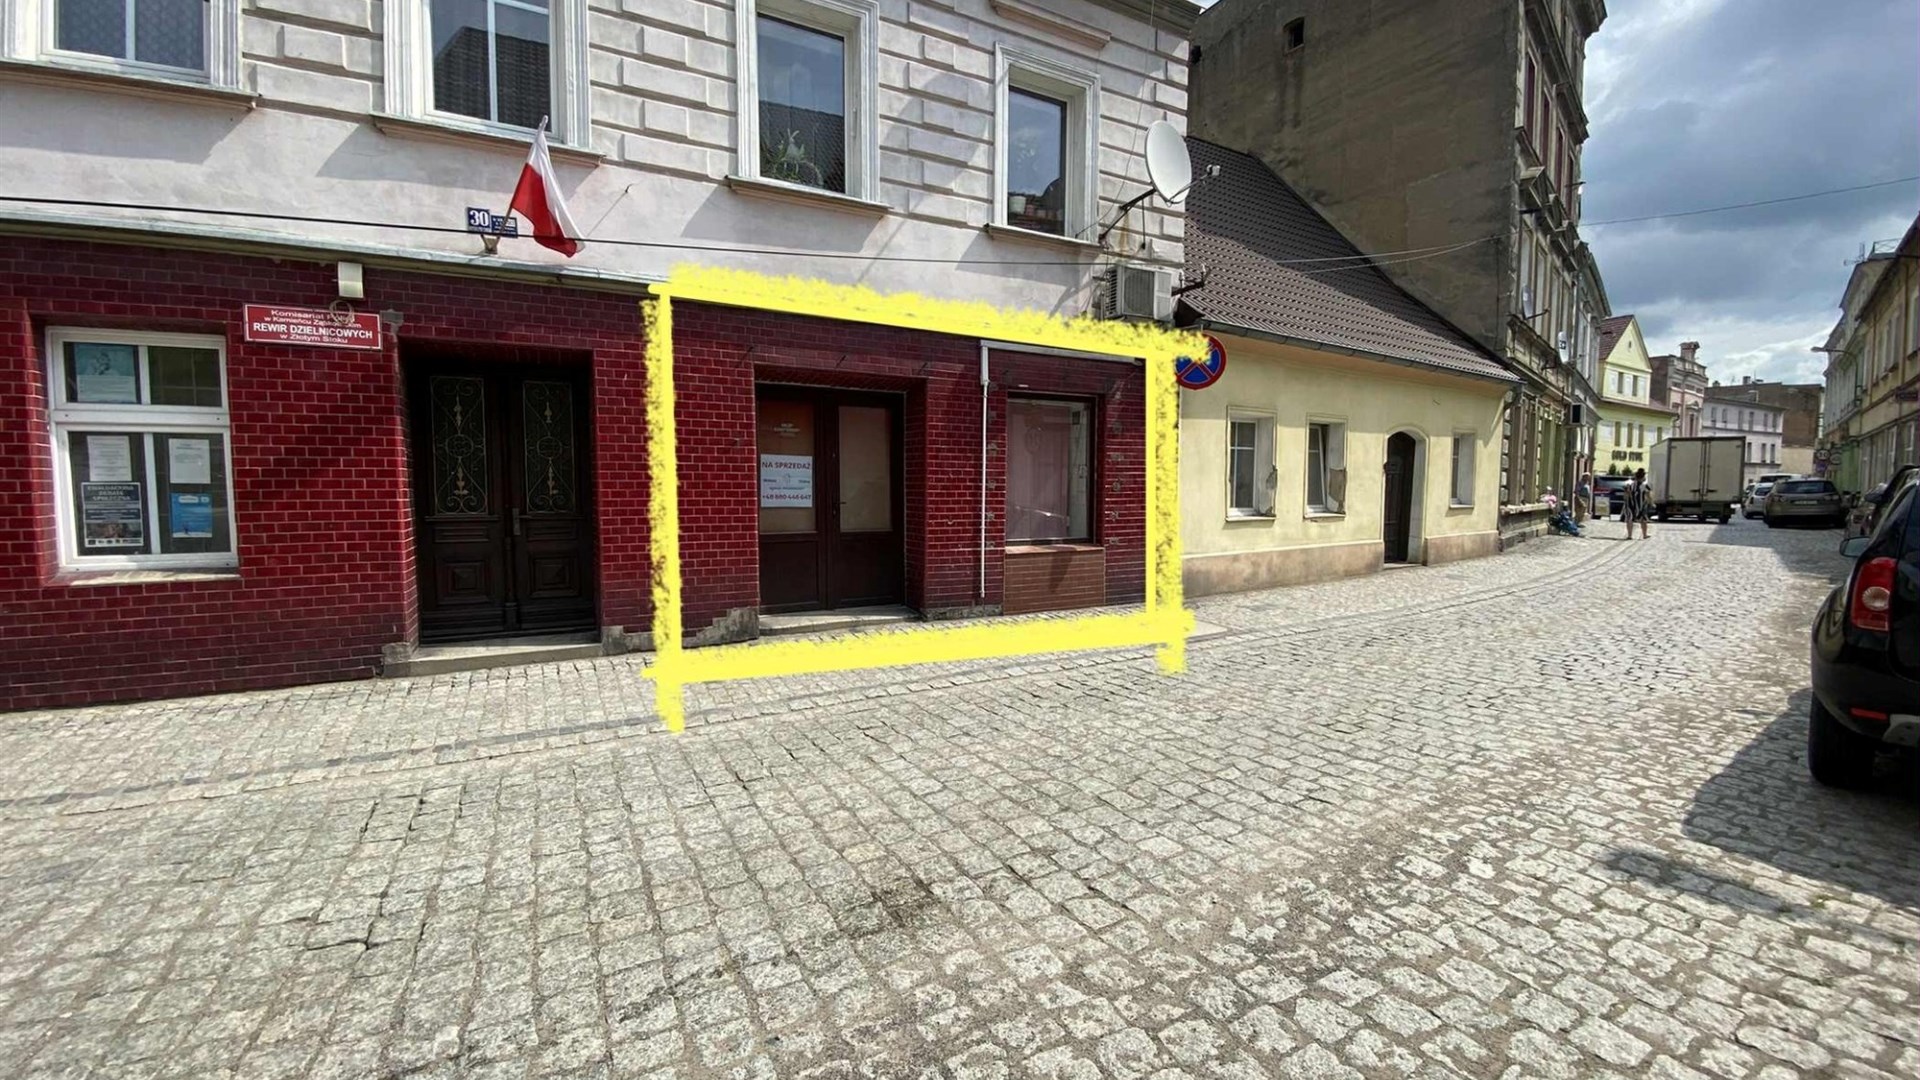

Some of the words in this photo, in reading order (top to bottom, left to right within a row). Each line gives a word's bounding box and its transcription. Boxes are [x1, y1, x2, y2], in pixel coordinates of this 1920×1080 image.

[470, 210, 489, 226] 30
[271, 309, 325, 320] Komisariat
[253, 322, 288, 334] REWIR
[290, 325, 373, 339] DZIELNICOWYCH
[290, 333, 320, 342] Złotym
[323, 336, 348, 344] Stoku
[762, 461, 773, 469] NA
[775, 461, 811, 470] SPRZEDAŻ
